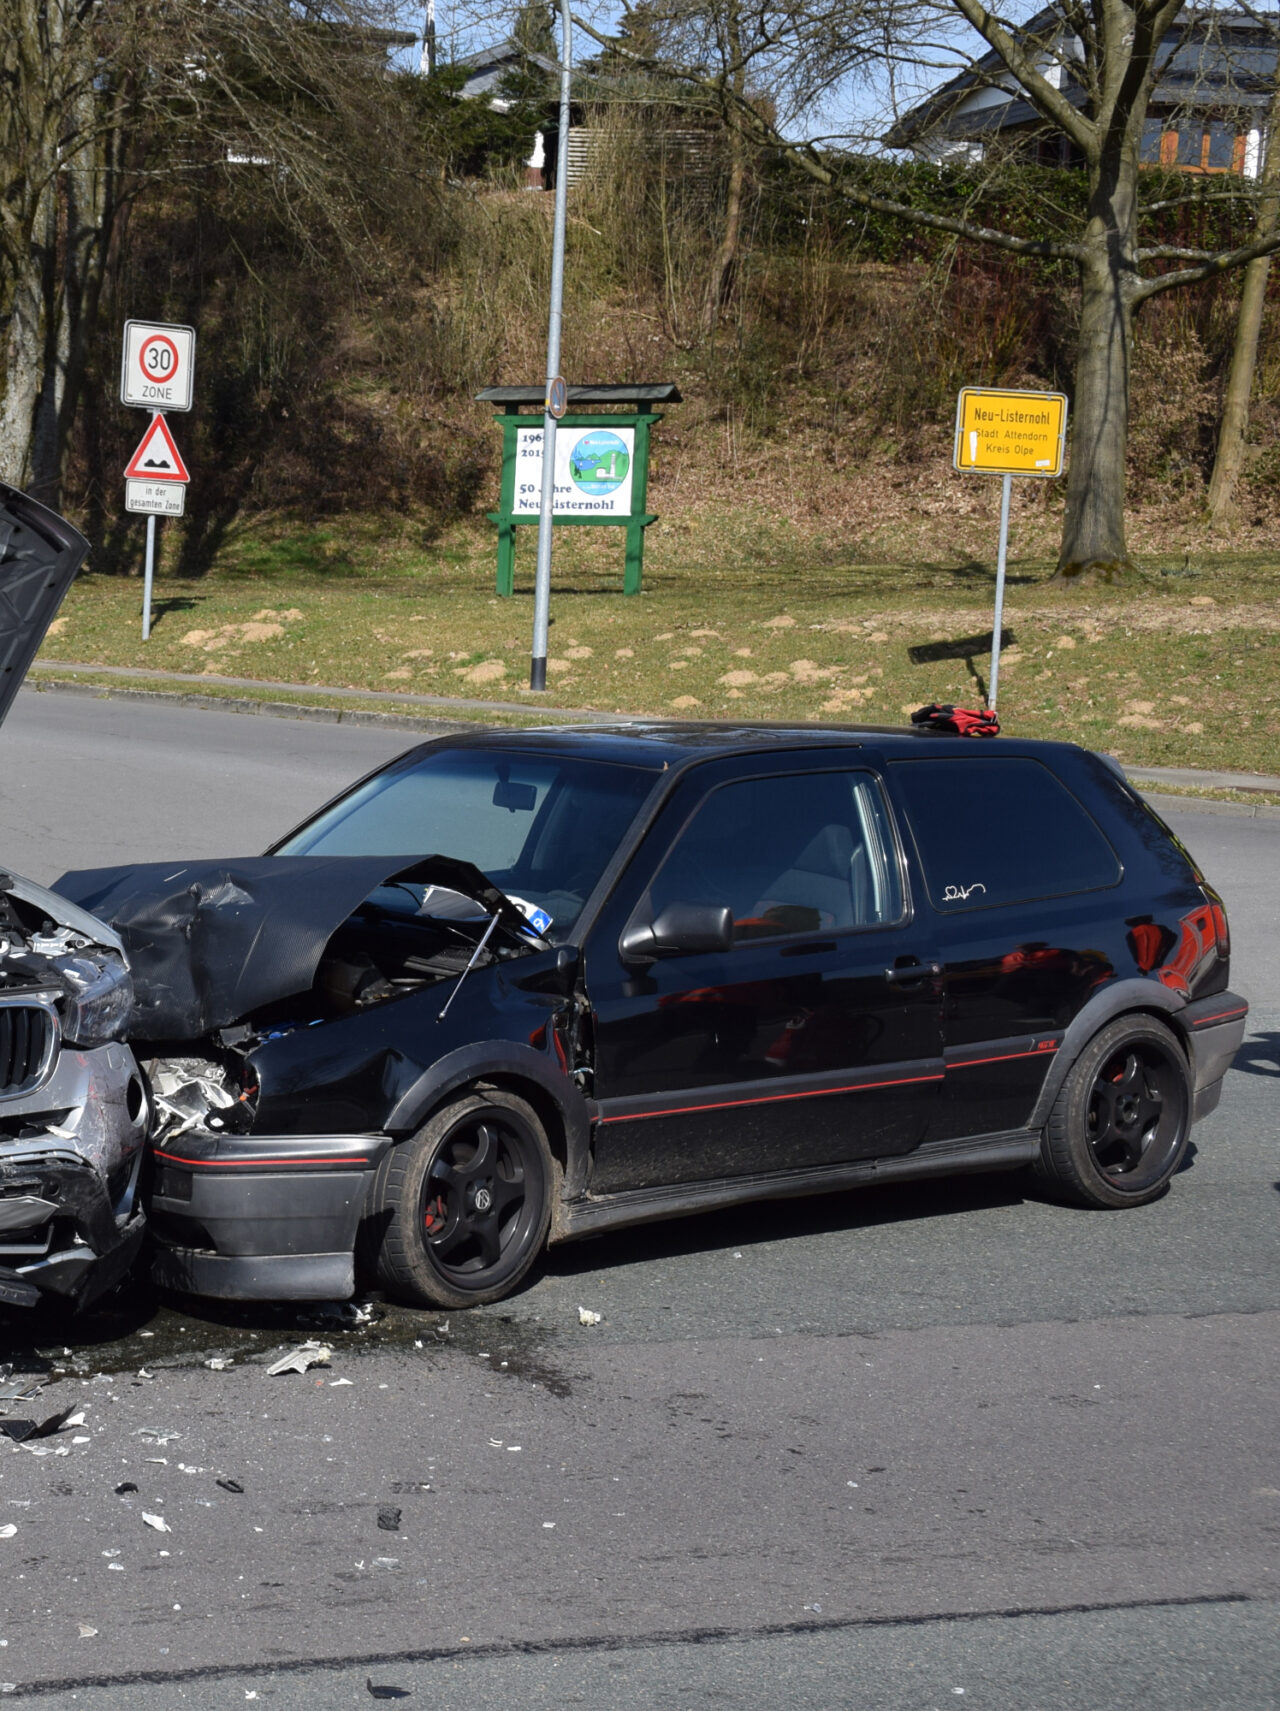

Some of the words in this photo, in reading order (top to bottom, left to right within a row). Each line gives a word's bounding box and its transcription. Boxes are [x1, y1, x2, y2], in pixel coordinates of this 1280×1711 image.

[148, 347, 171, 370] 30
[142, 385, 172, 400] ZONE
[974, 407, 1050, 425] Neu-Listernohl
[522, 433, 544, 443] 196
[976, 428, 999, 439] Stadt
[1004, 430, 1048, 441] Attendorn
[521, 449, 544, 458] 201
[986, 443, 1010, 454] Kreis
[1014, 444, 1034, 457] Olpe
[145, 487, 153, 496] in
[155, 487, 167, 496] der
[519, 483, 535, 494] 50
[130, 498, 162, 509] gesamten
[165, 500, 180, 511] Zone
